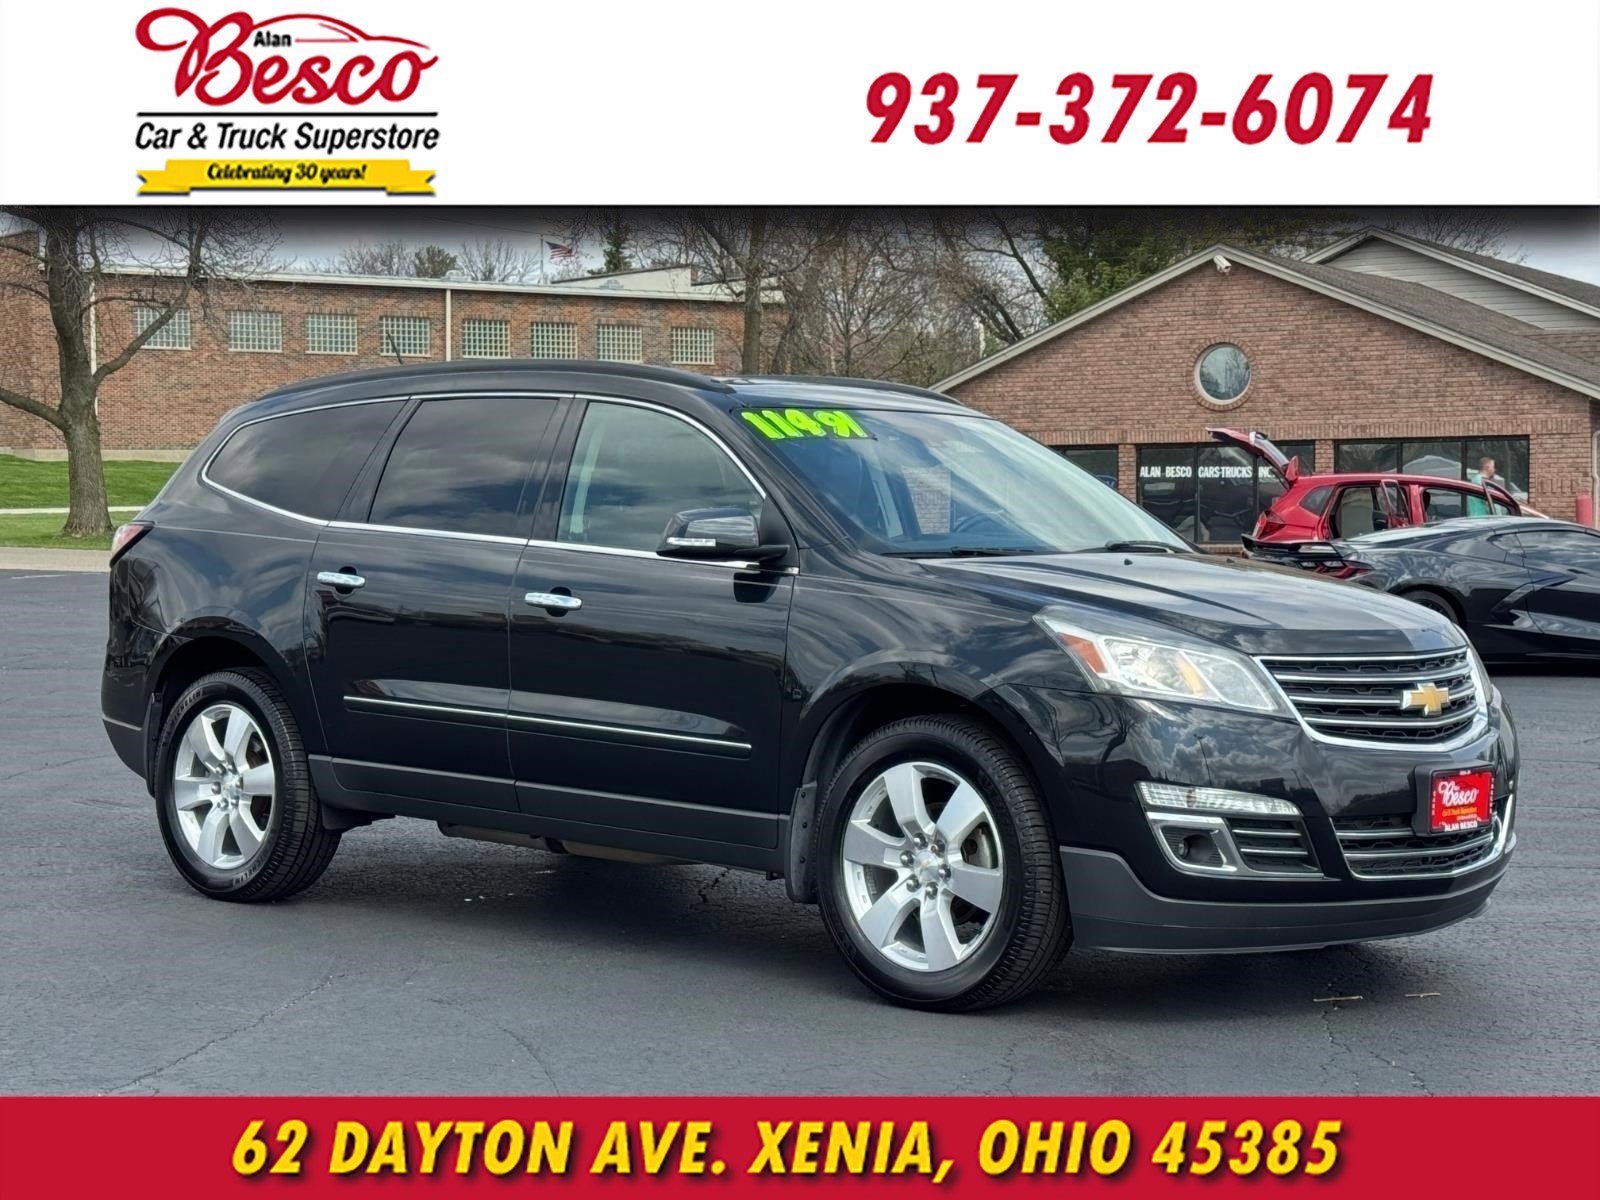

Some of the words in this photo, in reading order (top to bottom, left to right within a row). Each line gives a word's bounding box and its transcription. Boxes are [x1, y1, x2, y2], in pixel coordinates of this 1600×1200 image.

[1140, 465, 1162, 479] ALAN
[1165, 465, 1193, 478] BESCO
[1438, 780, 1480, 808] Besco
